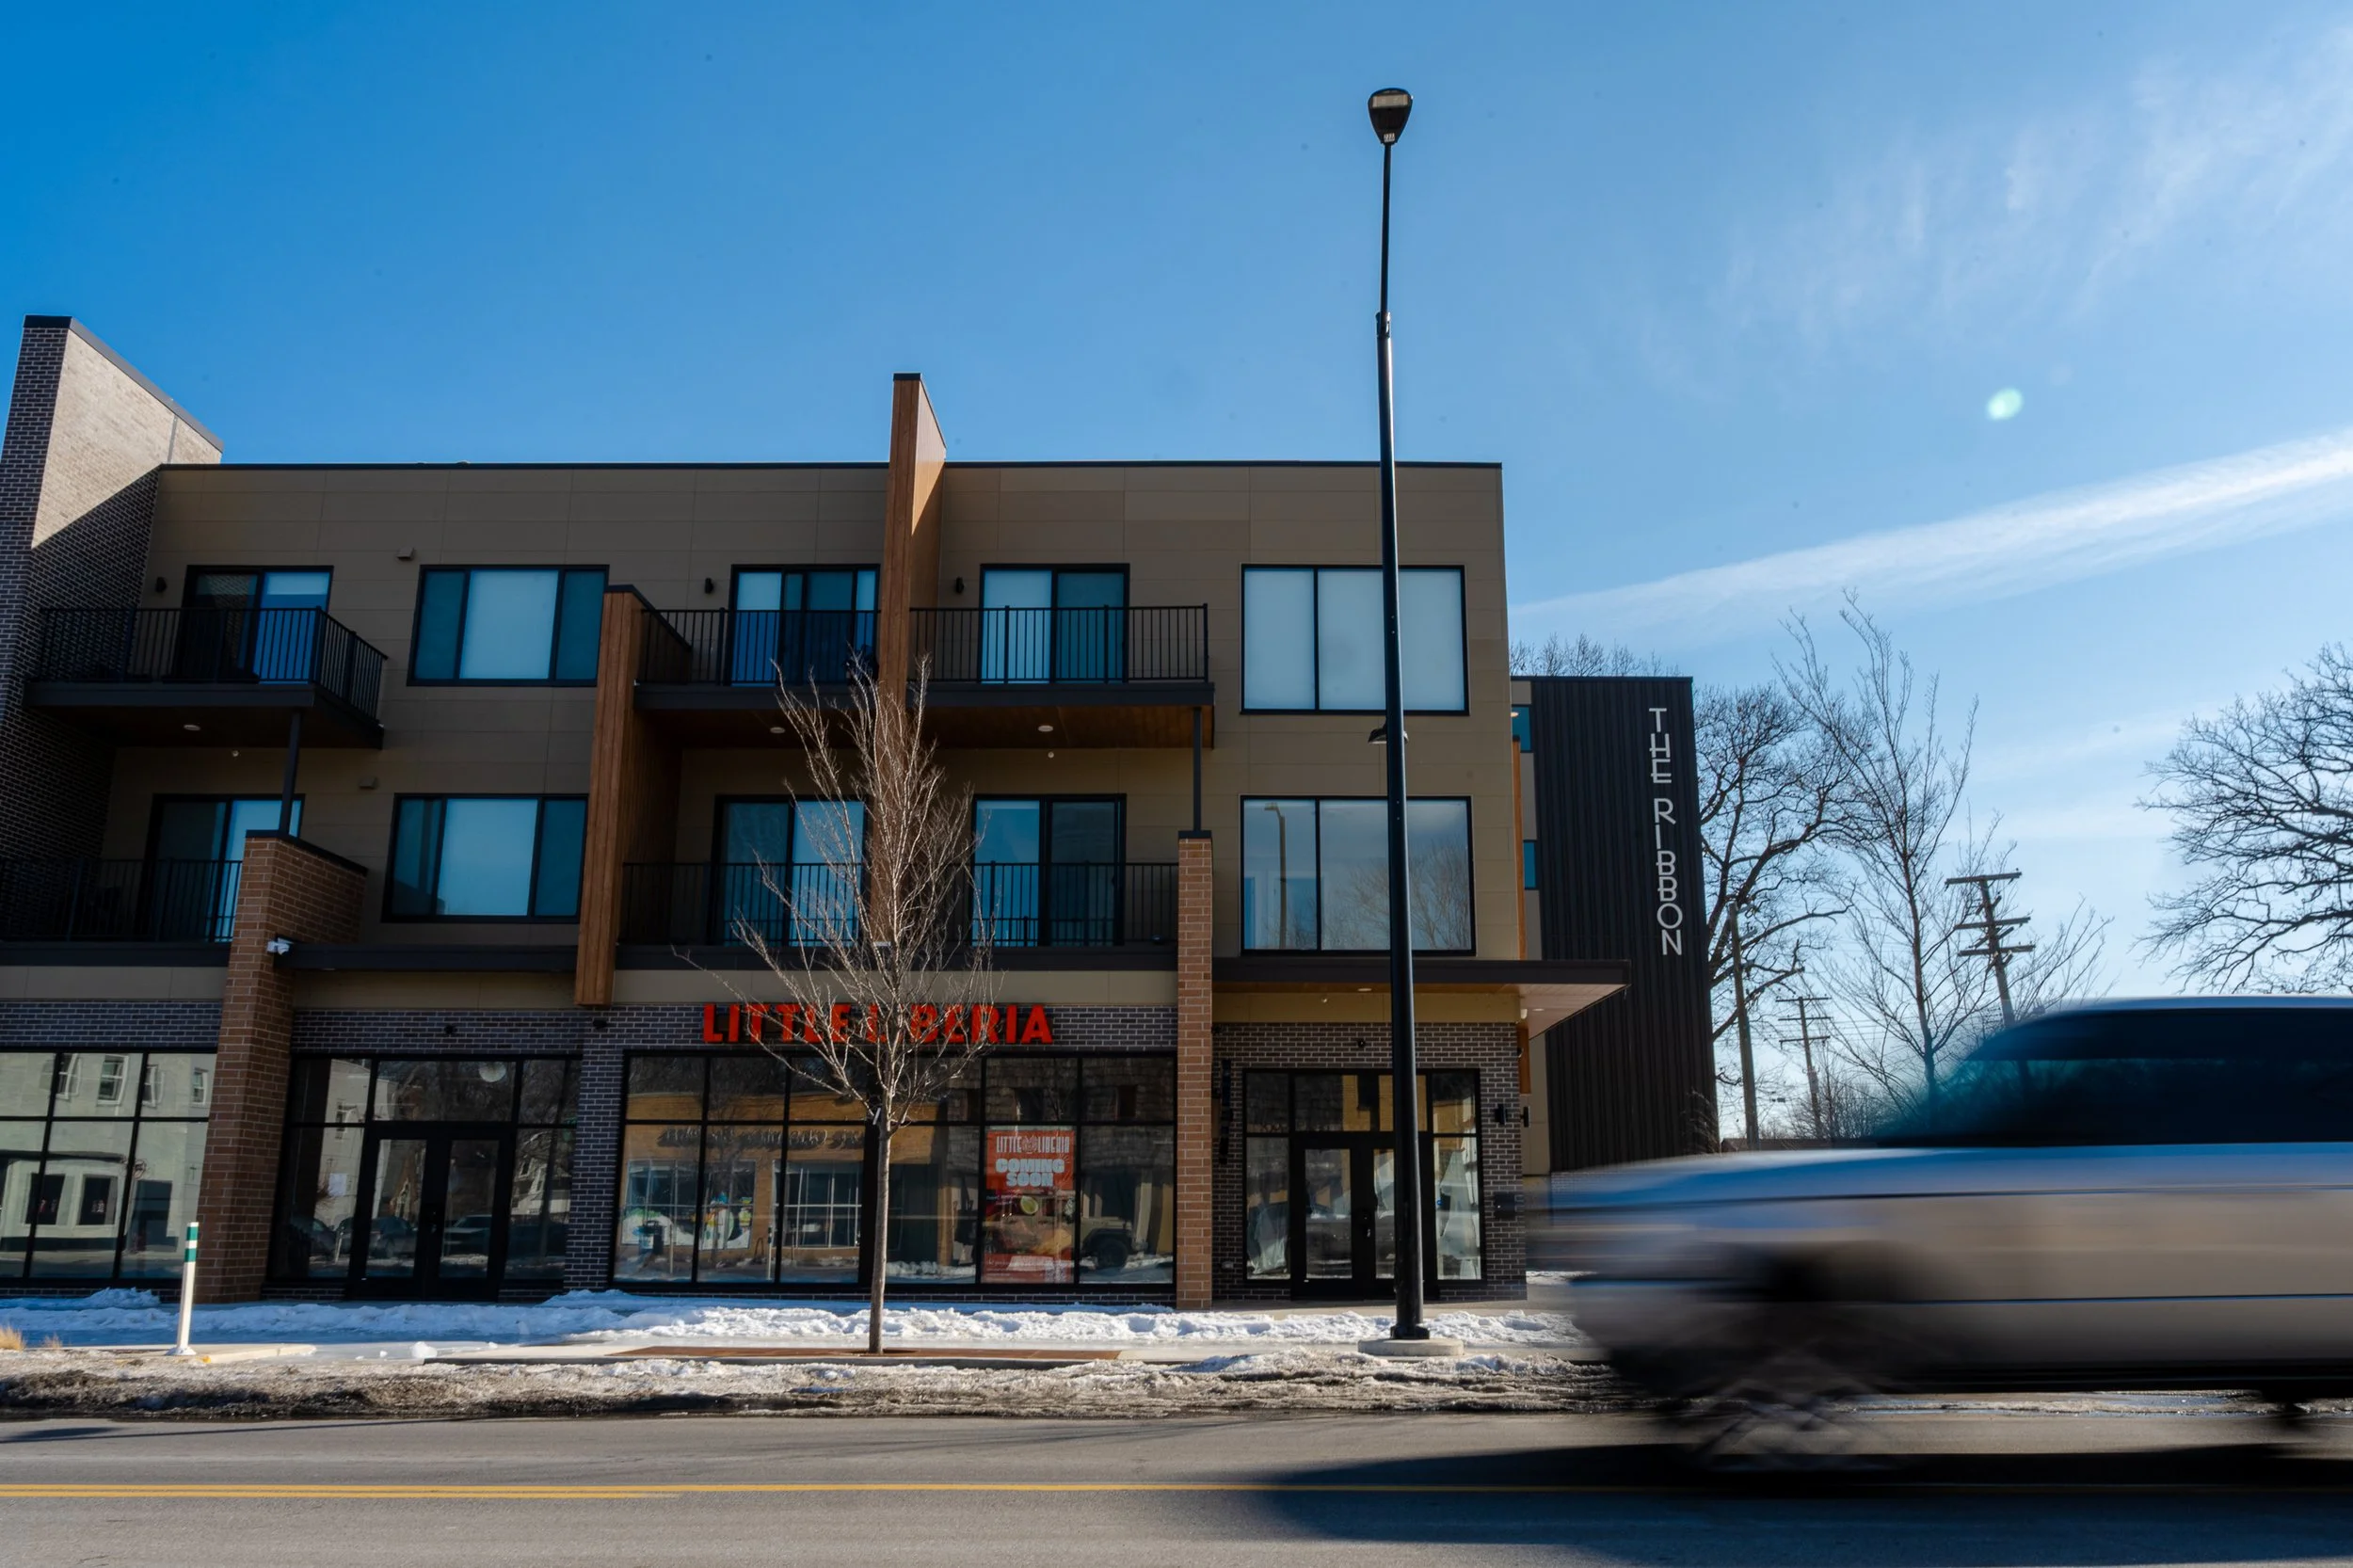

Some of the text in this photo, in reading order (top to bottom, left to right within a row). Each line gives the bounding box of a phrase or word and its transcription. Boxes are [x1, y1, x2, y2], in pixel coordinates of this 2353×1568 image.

[1649, 707, 1683, 956] THE RIBBON
[703, 1002, 1053, 1044] LITTLE LBERIA
[996, 1135, 1070, 1154] LITTLE LIBERIA
[995, 1158, 1065, 1174] COMING
[1006, 1172, 1054, 1188] SOON
